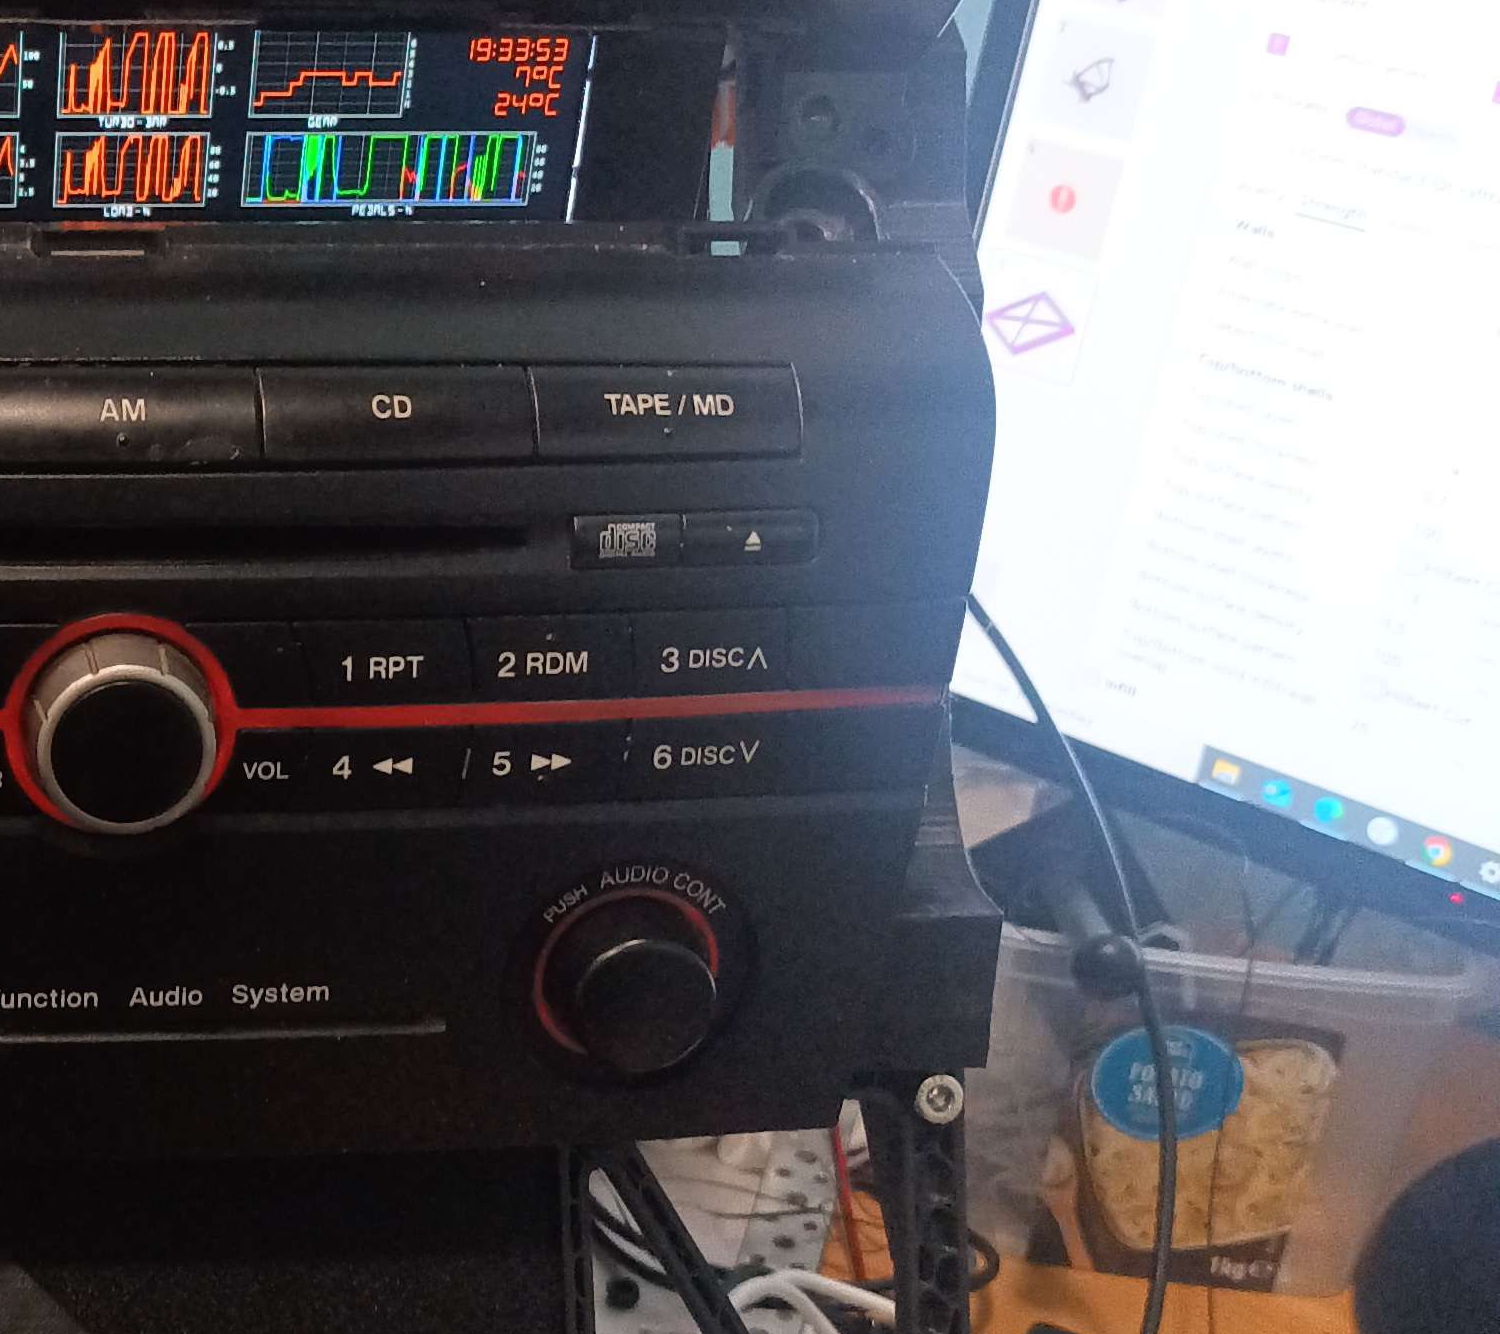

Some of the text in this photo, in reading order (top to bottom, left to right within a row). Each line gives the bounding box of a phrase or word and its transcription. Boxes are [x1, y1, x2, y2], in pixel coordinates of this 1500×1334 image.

[468, 37, 570, 63] 19:33:53
[100, 397, 147, 423] AM
[370, 394, 414, 420] CD
[604, 392, 672, 416] TAPE
[692, 392, 735, 417] MD
[341, 655, 425, 682] 1 RPT
[497, 650, 589, 678] 2 RDM
[660, 646, 745, 674] 3 DISC
[242, 760, 289, 781] VOL
[331, 754, 353, 780] 4
[491, 751, 512, 777] 5
[652, 744, 737, 771] 6 DISC
[543, 865, 728, 924] PUSH AUDIO CONT
[129, 985, 204, 1008] Audio
[231, 982, 331, 1009] System
